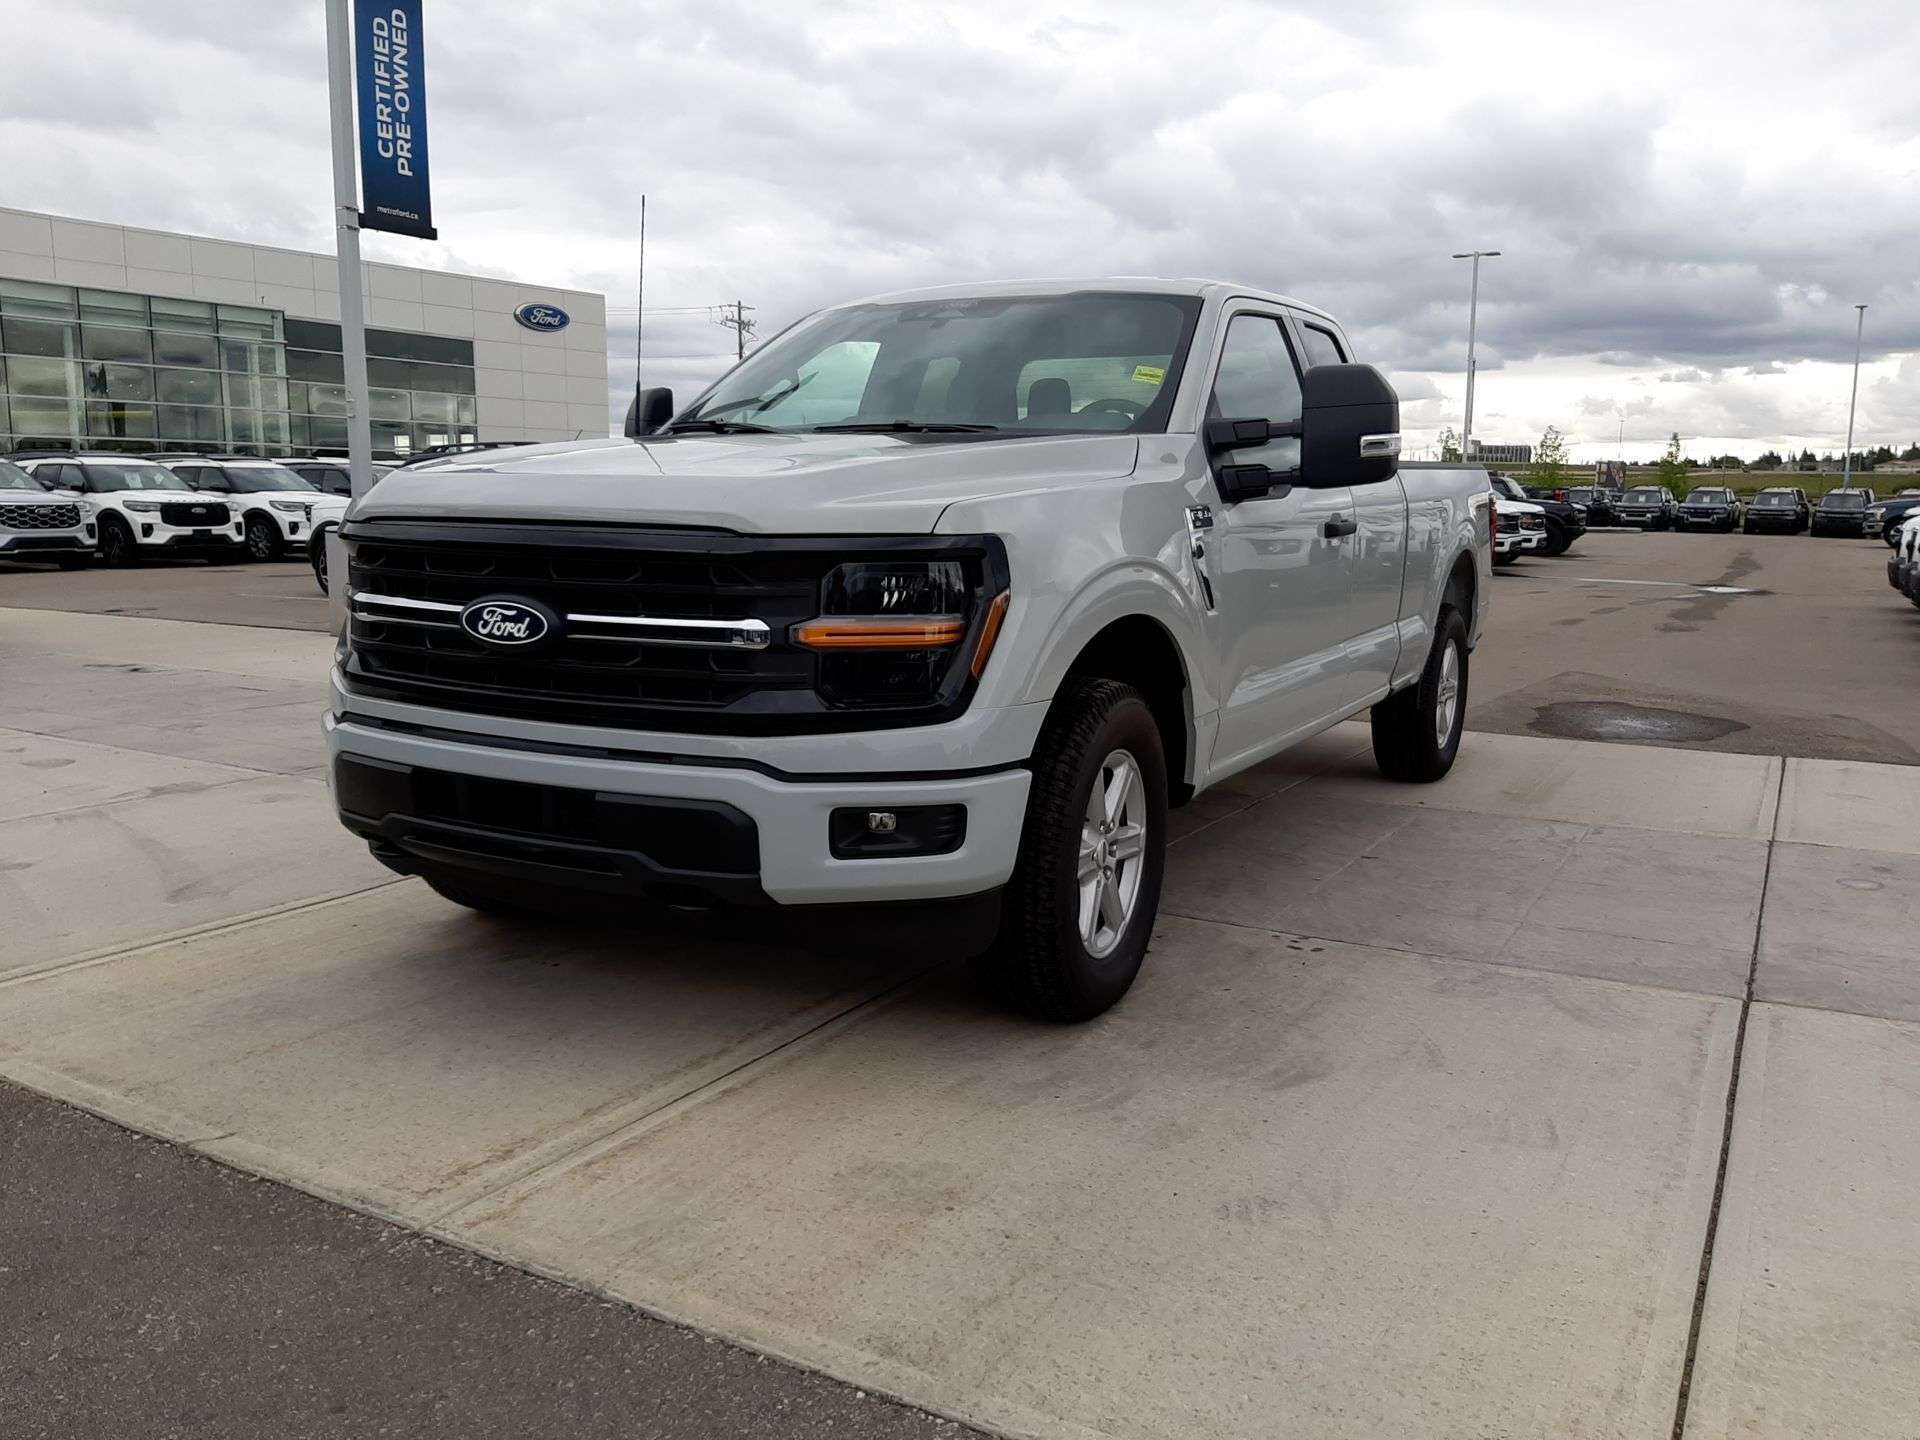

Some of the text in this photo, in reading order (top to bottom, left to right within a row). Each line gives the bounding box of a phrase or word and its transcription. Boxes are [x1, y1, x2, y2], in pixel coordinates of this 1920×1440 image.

[372, 16, 394, 159] CERTIFIED
[391, 8, 413, 177] PRE-OWNED
[530, 307, 561, 326] Ford
[478, 606, 531, 638] Ford
